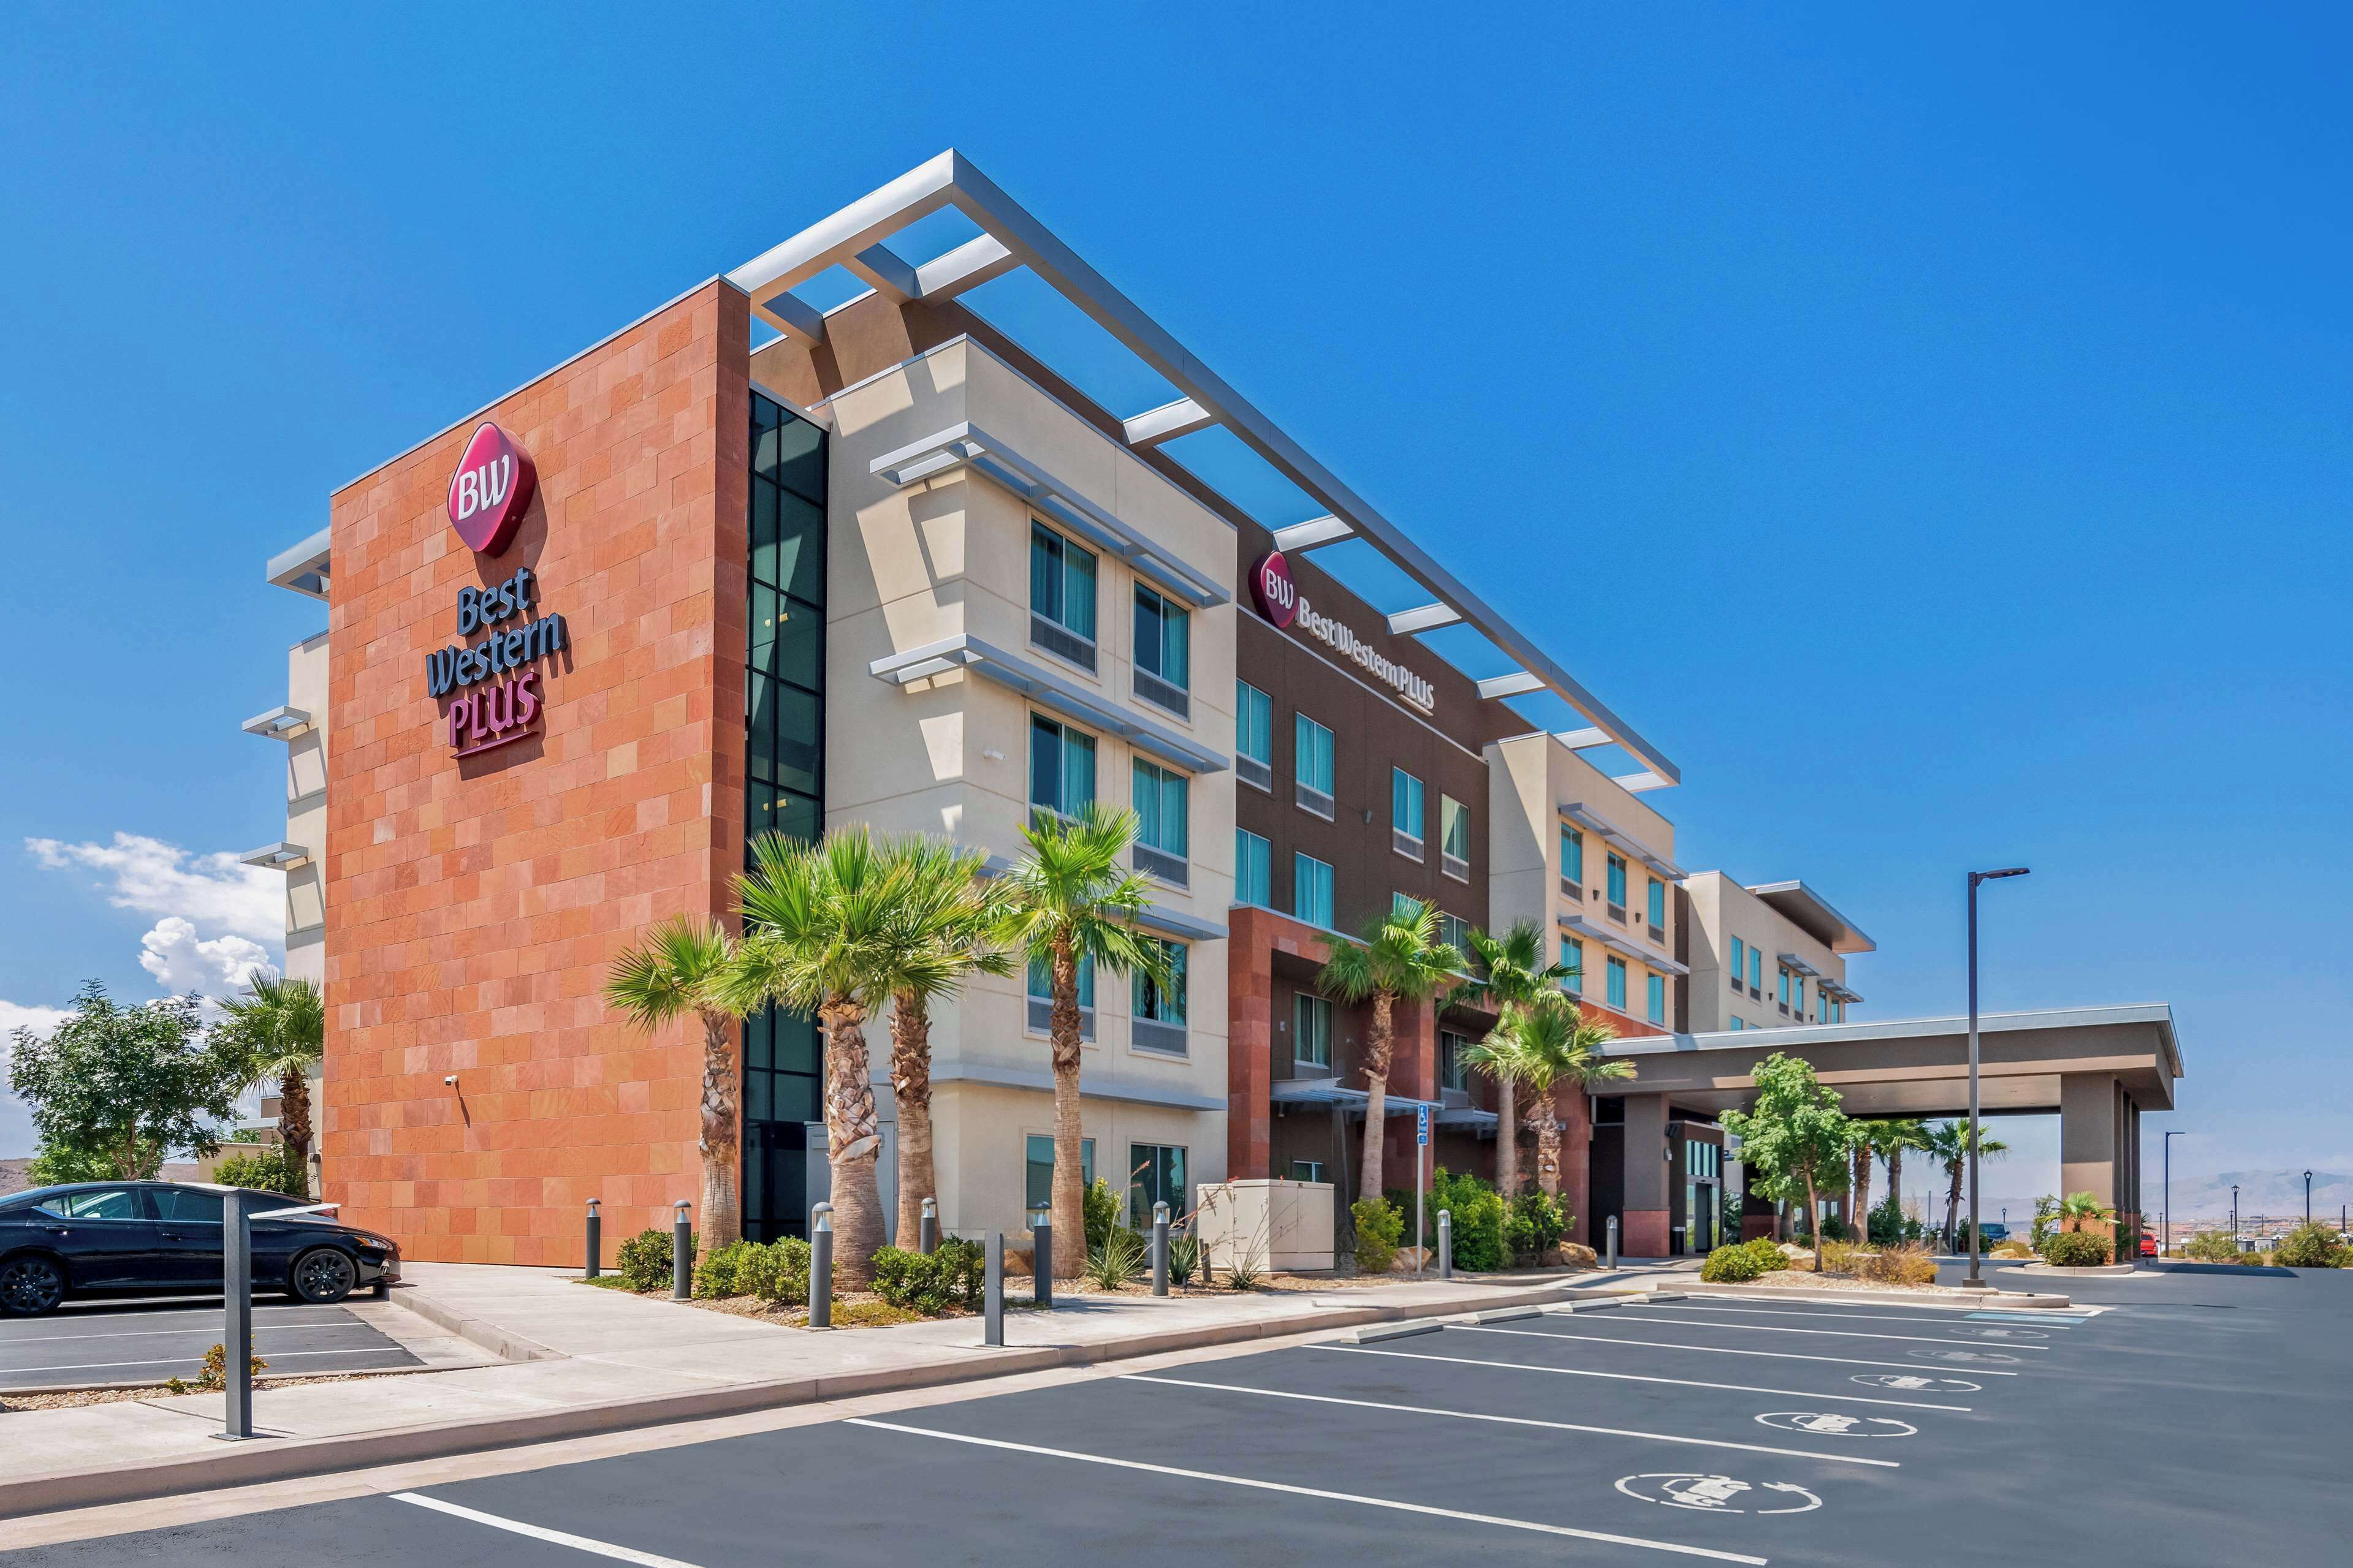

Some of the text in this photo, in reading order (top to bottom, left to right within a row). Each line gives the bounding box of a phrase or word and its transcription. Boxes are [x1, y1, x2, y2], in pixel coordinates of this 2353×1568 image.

[458, 453, 510, 521] BW
[457, 565, 534, 637] Best
[1266, 568, 1294, 610] BW
[425, 612, 566, 700] Western
[449, 671, 541, 748] PLUS
